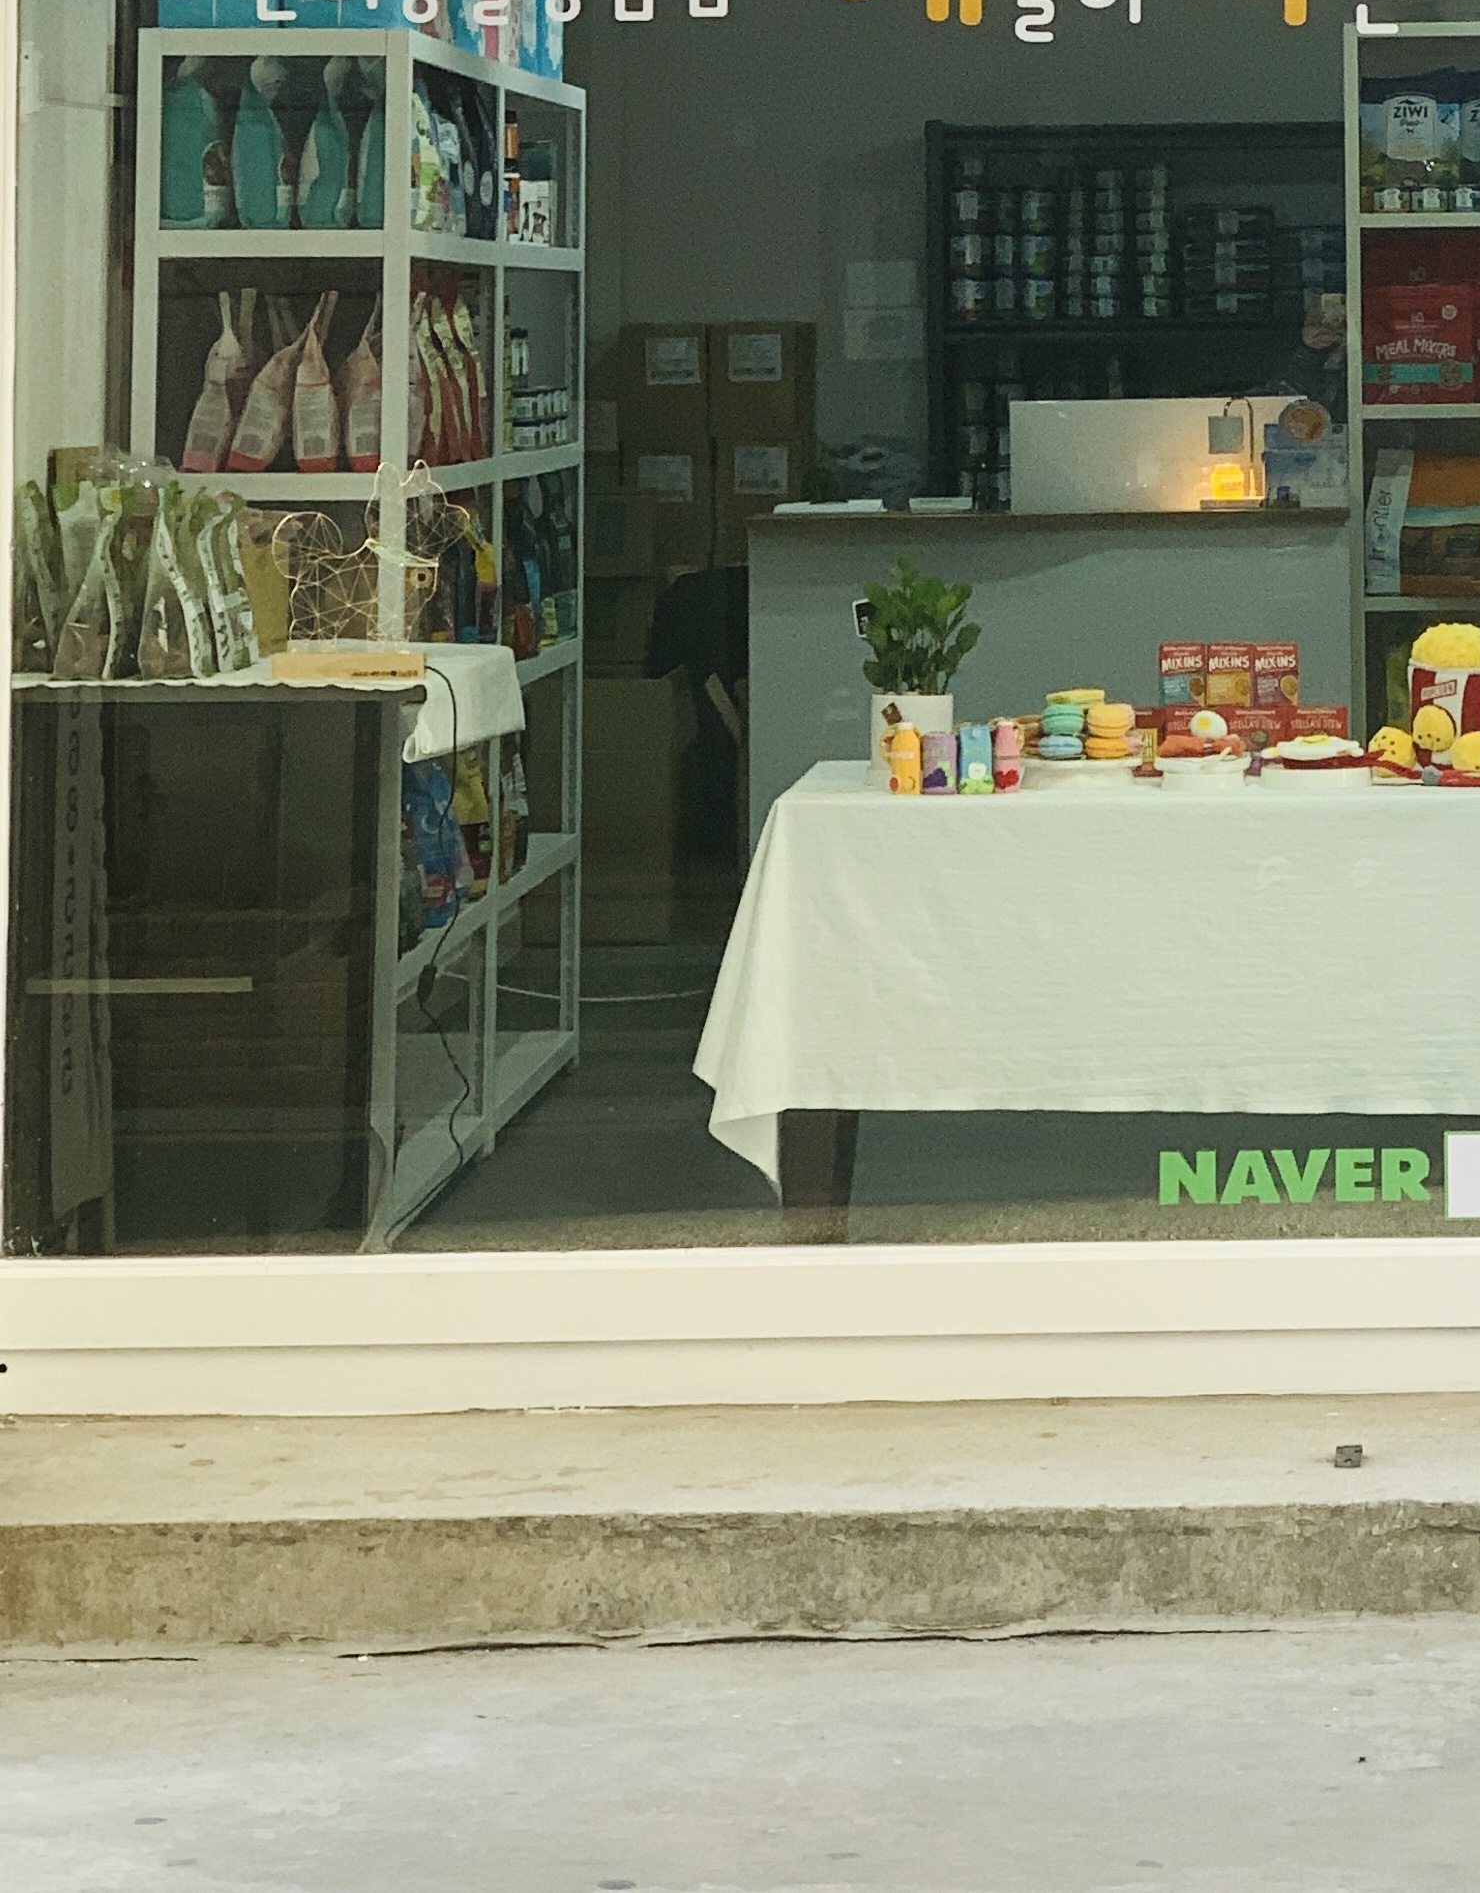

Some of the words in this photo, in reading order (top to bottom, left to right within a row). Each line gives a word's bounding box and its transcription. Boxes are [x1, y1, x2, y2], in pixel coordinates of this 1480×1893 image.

[1392, 105, 1429, 119] ZIWI
[1374, 339, 1410, 360] MEAL
[1158, 1146, 1431, 1205] NAVER
